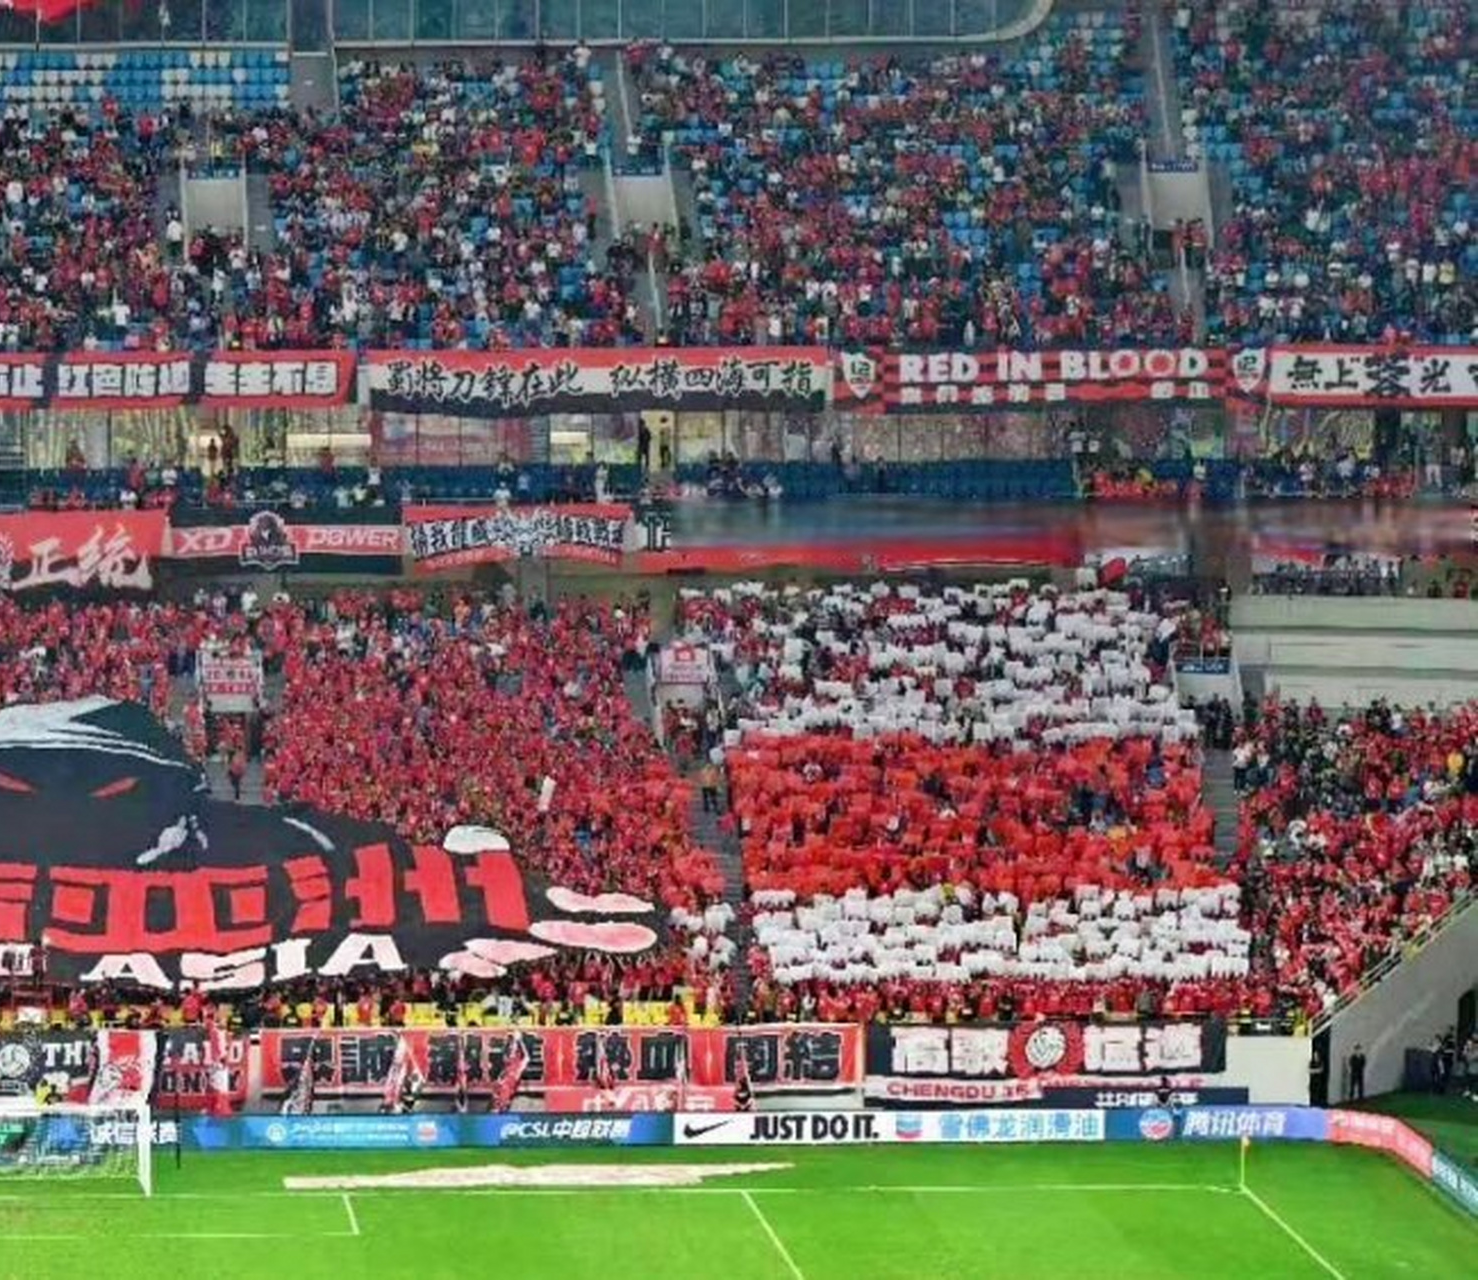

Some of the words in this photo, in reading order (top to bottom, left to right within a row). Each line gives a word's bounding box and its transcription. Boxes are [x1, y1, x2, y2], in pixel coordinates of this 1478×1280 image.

[899, 352, 980, 383] RED
[997, 349, 1043, 381] IN
[1060, 348, 1209, 380] BLOOD
[306, 528, 398, 550] POWER
[79, 934, 409, 991] ASIA
[886, 1081, 997, 1099] CHENGDU
[749, 1115, 808, 1140] JUST
[811, 1115, 850, 1139] DO
[853, 1115, 880, 1138] IT.
